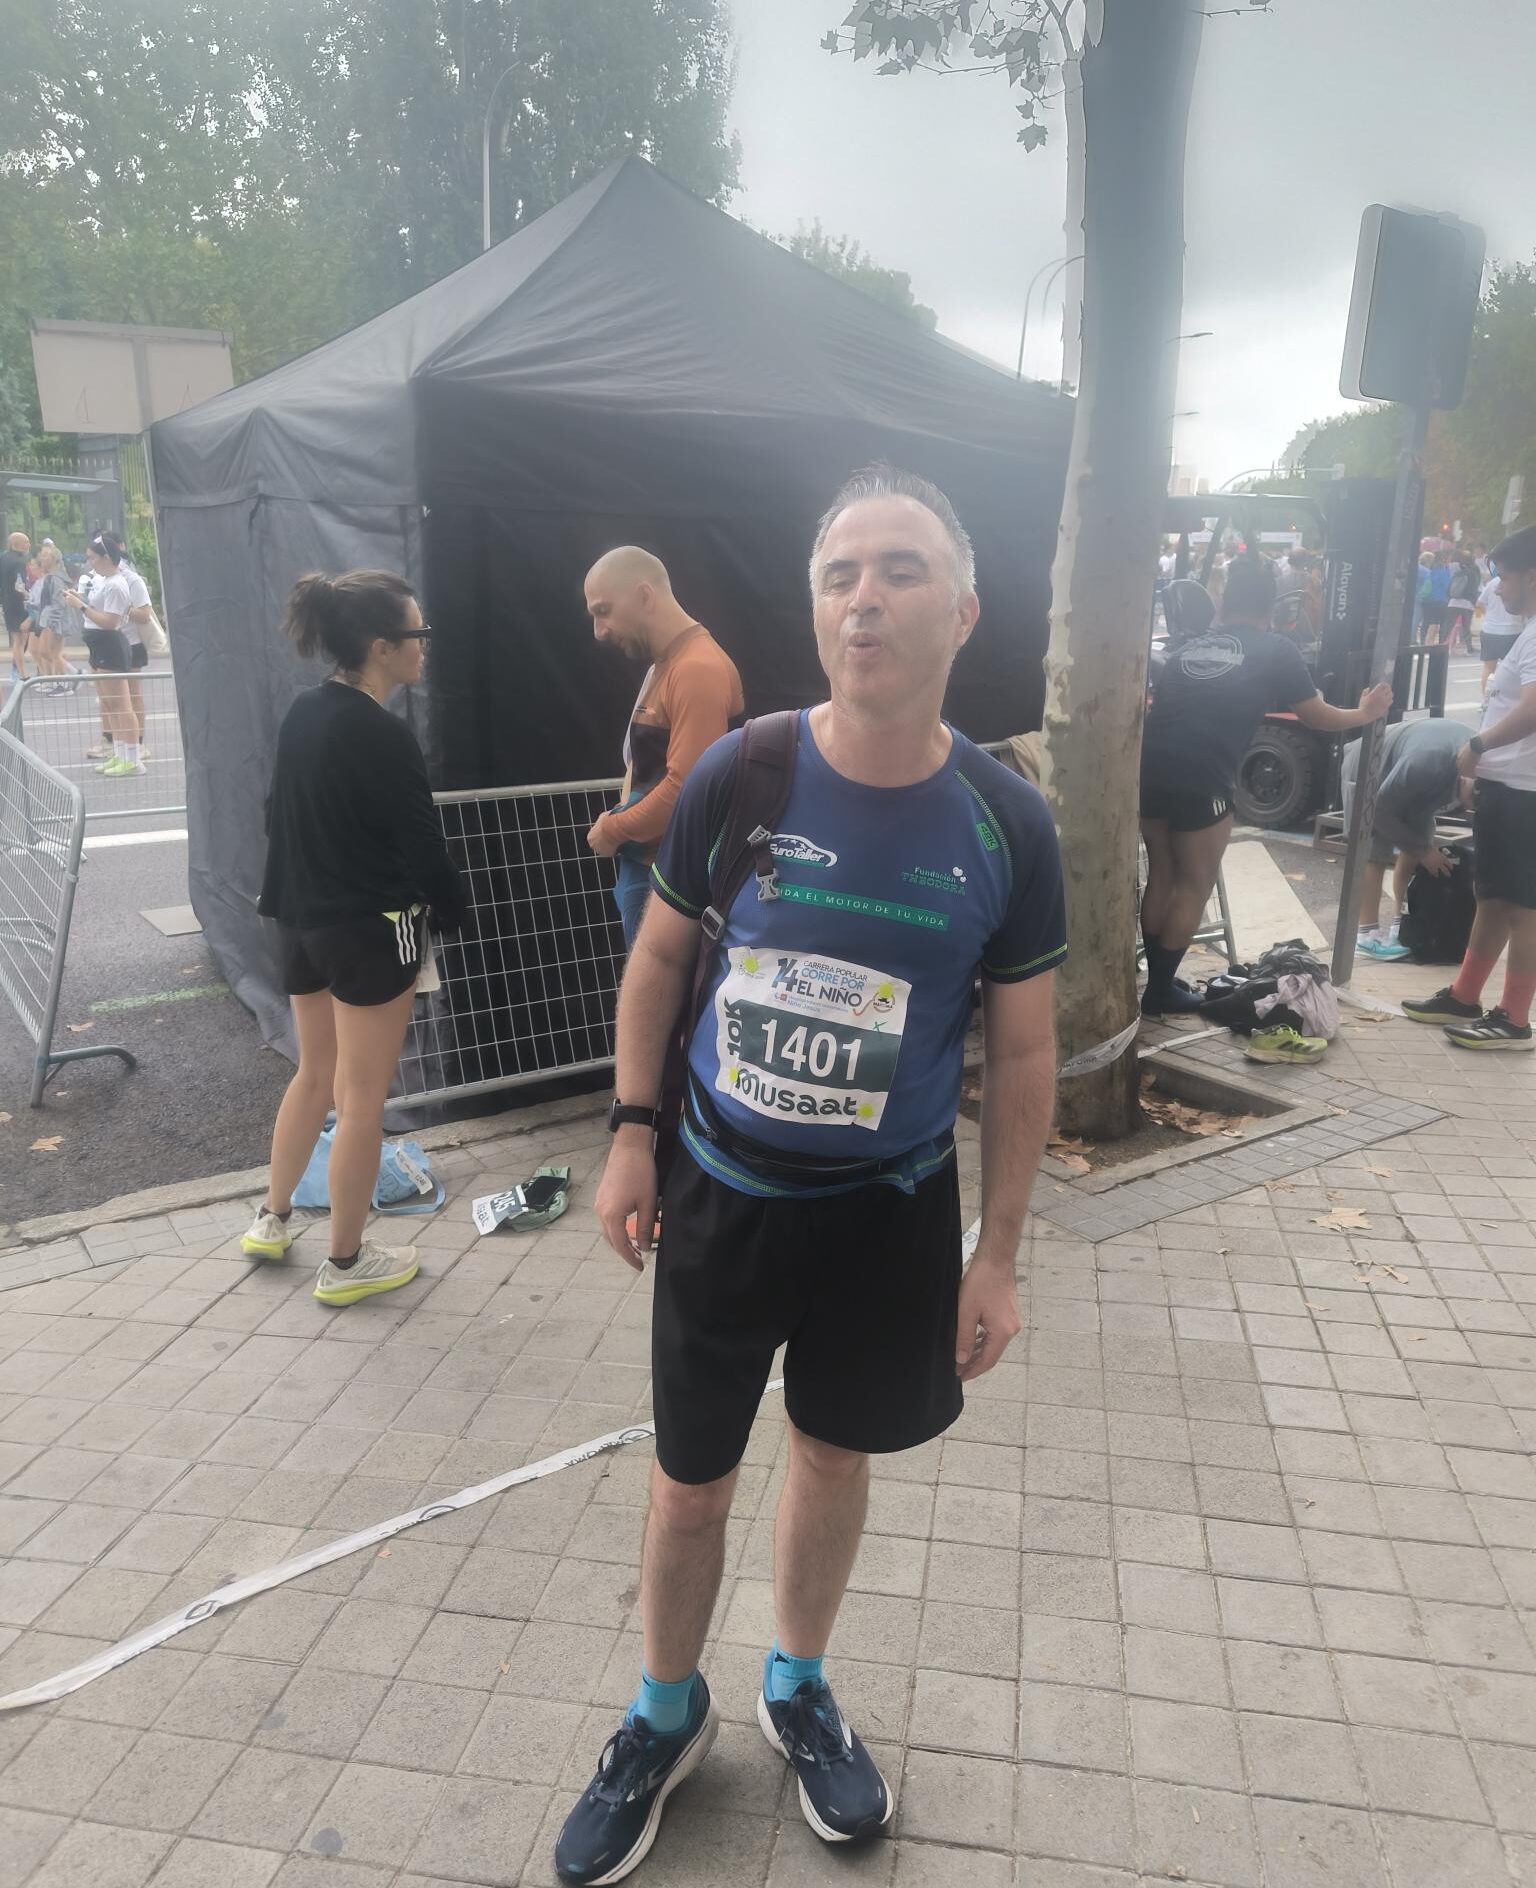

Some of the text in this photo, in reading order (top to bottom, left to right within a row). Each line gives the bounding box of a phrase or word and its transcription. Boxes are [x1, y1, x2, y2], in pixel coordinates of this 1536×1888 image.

[1337, 560, 1353, 611] Alayan
[770, 843, 824, 862] EuroTaller
[914, 866, 956, 884] Fundación
[780, 888, 944, 926] IDA EL MOTOR DE TU VIDA
[801, 967, 865, 991] CORRE POR
[803, 960, 868, 981] CARRERA POPULAR
[797, 980, 815, 997] EL
[819, 985, 863, 1007] NIÑO
[761, 1018, 863, 1081] 1401
[735, 1067, 857, 1116] musaat
